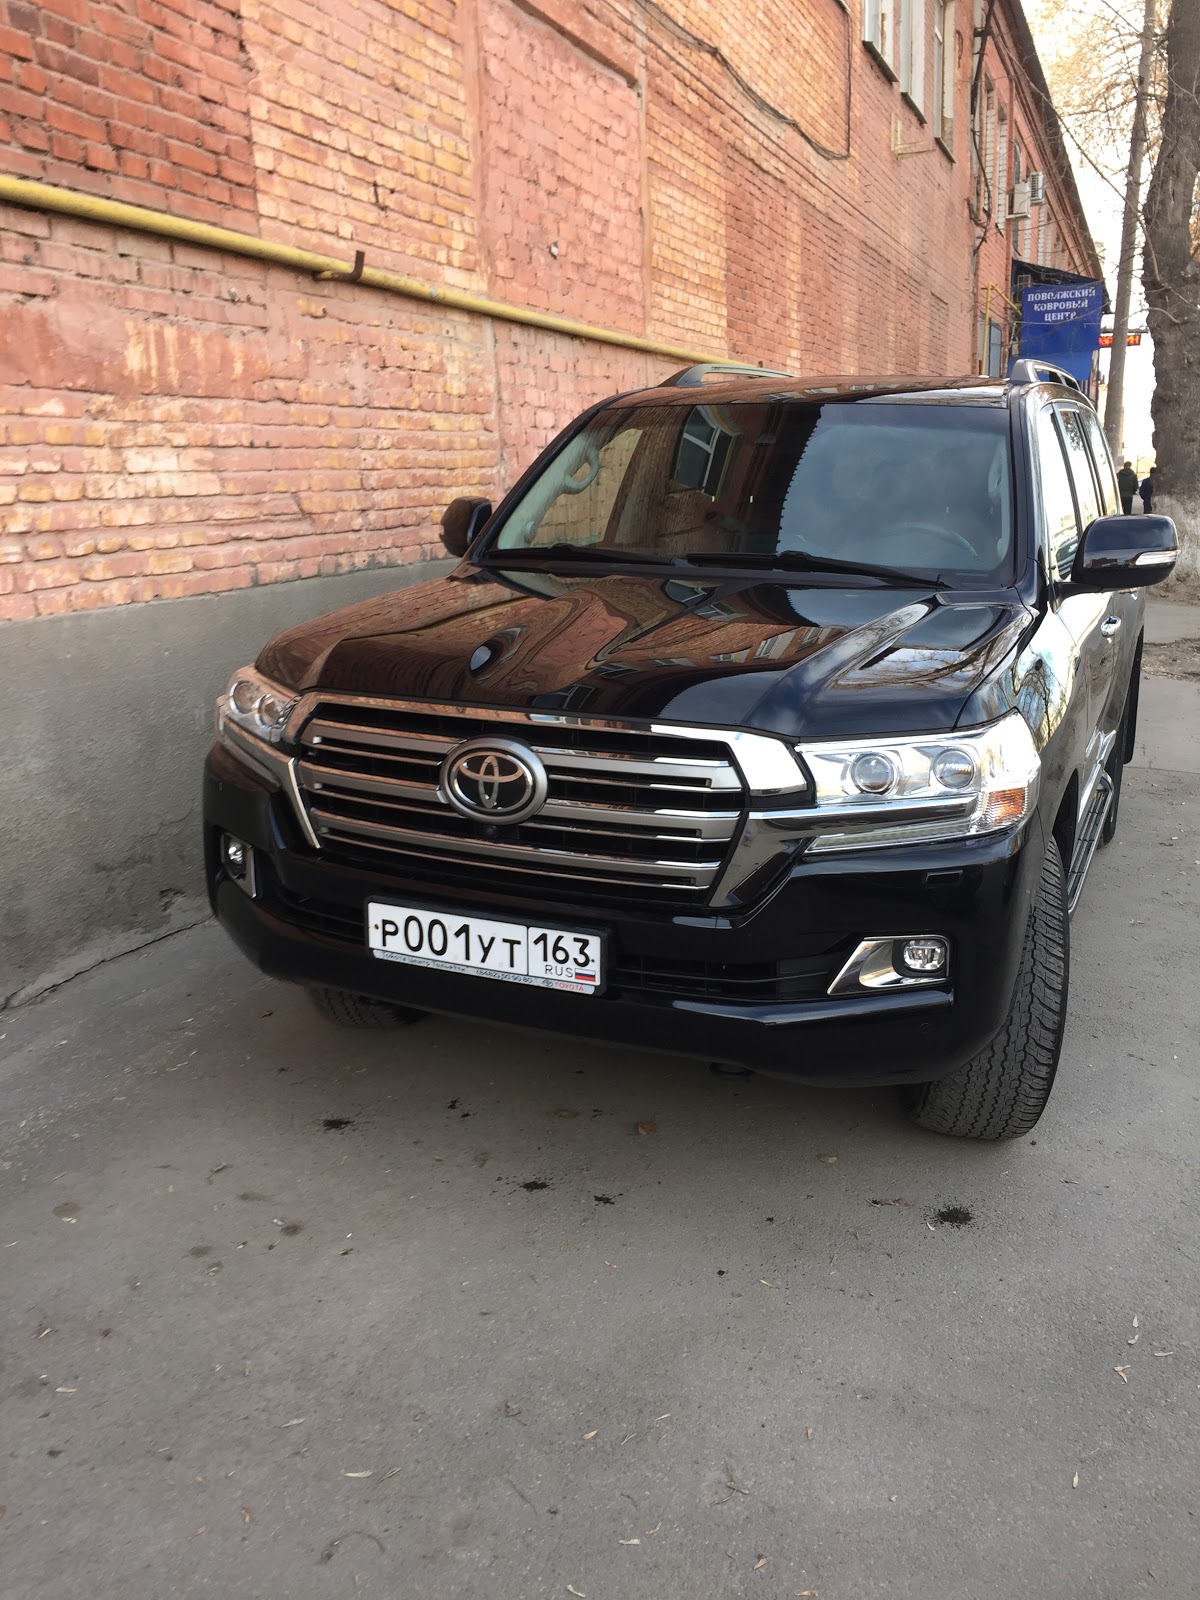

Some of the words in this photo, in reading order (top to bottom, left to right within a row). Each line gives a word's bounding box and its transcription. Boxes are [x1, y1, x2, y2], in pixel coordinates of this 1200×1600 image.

[1027, 286, 1096, 302] ПОВОЛЖСКИЙ
[1033, 299, 1089, 312] КОВРОВЫЙ
[1044, 311, 1077, 322] ЦЕНТР
[381, 915, 522, 968] Р001УТ
[533, 932, 590, 967] 163
[544, 964, 574, 978] RUS
[554, 981, 585, 992] TOYOTA
